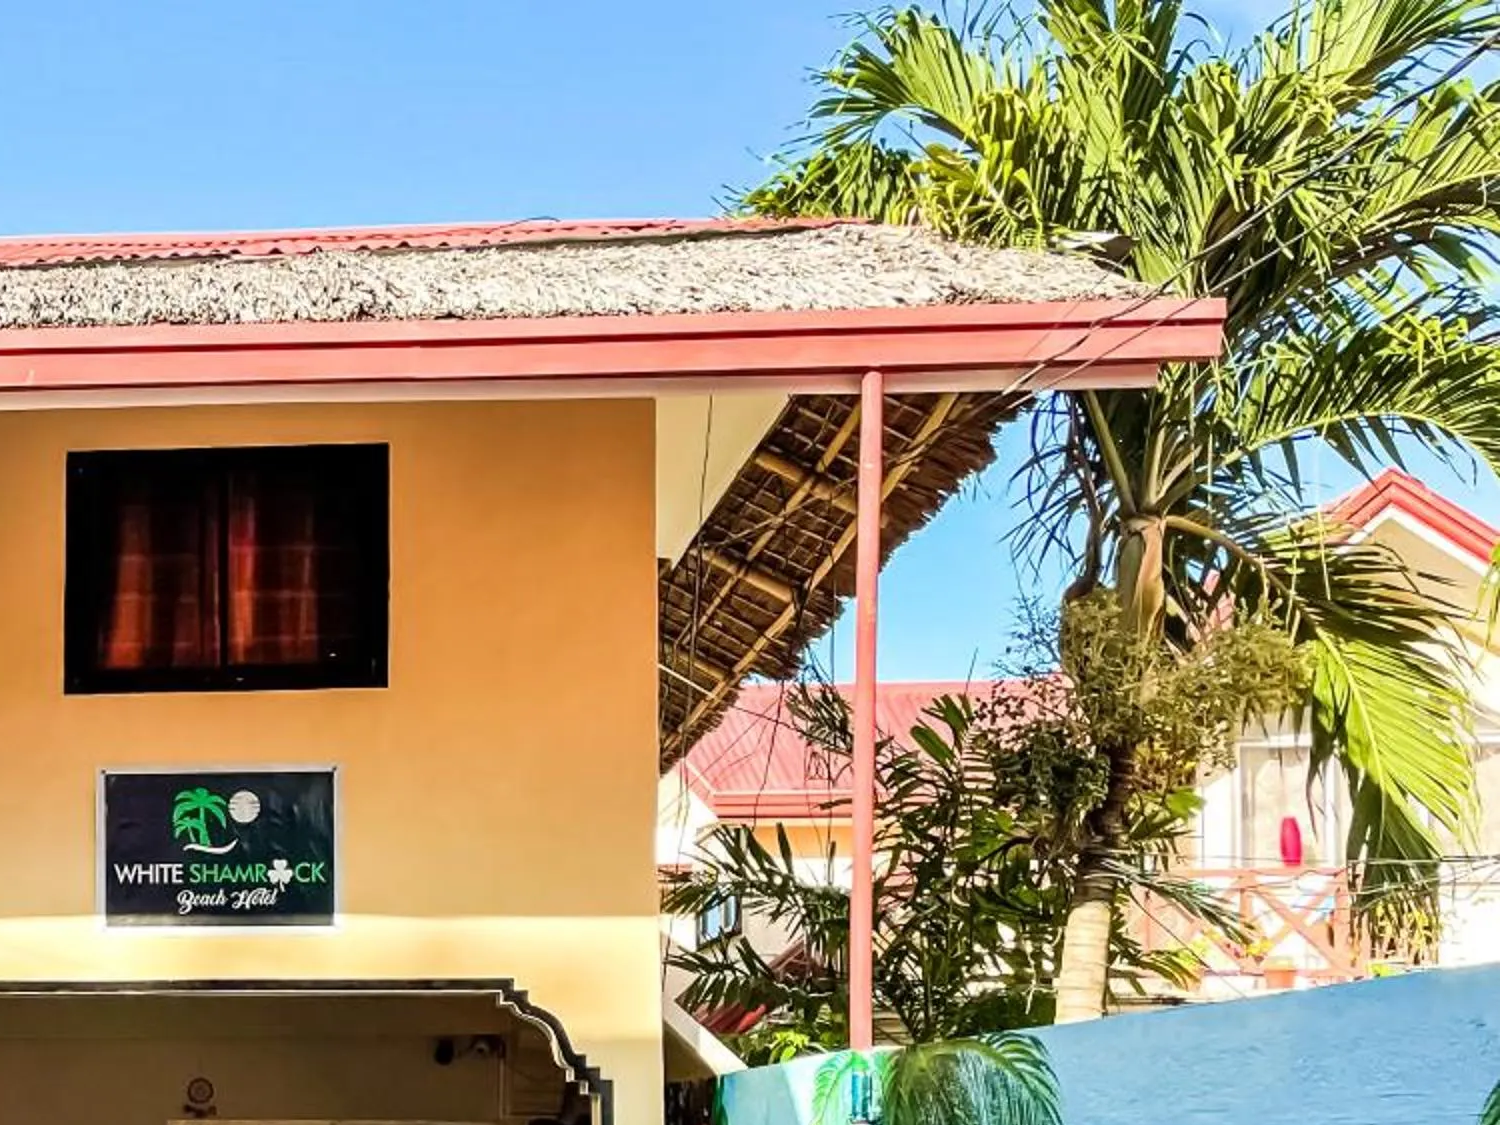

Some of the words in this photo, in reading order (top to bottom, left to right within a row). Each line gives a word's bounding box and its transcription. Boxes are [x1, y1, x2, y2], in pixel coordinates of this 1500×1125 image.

[113, 863, 184, 884] WHITE
[177, 888, 228, 915] Beach
[231, 887, 279, 910] Hotel
